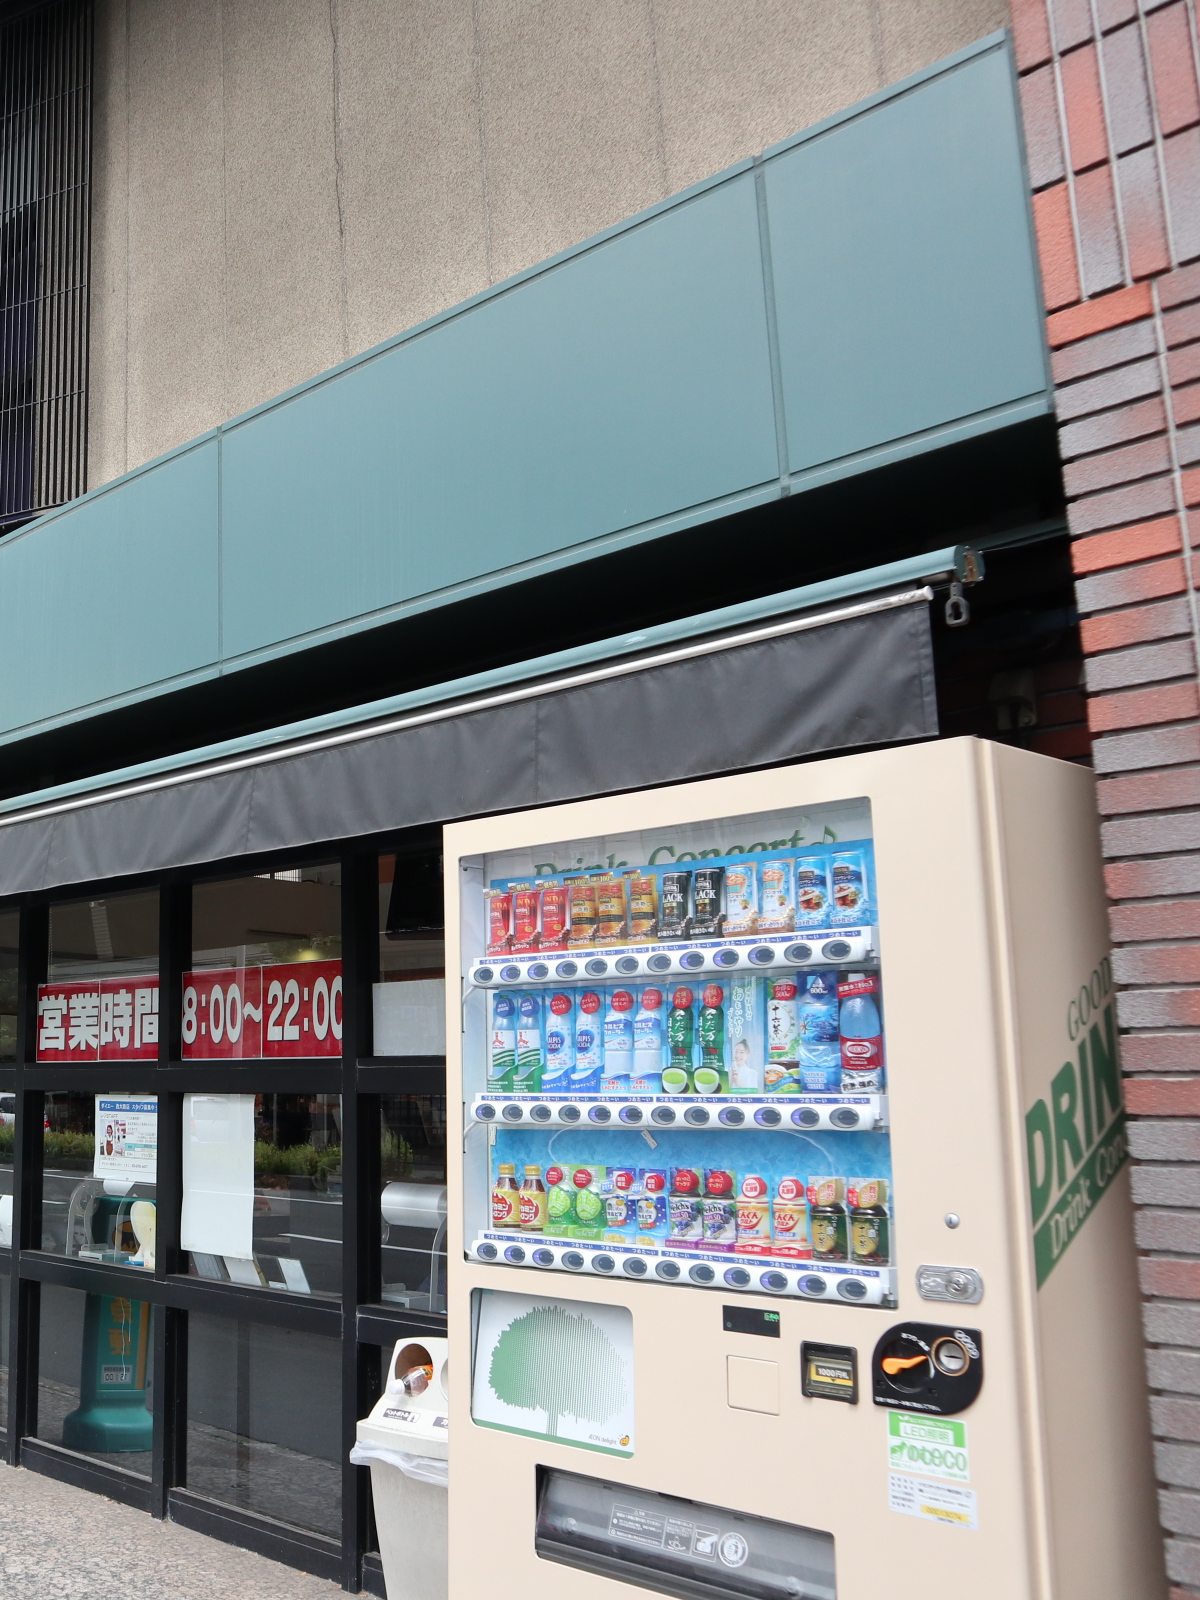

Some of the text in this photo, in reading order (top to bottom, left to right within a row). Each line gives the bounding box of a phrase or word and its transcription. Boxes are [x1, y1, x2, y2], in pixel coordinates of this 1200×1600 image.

[38, 988, 159, 1051] 営業時間
[1067, 956, 1113, 1041] GOOD
[1050, 1176, 1092, 1260] Drink
